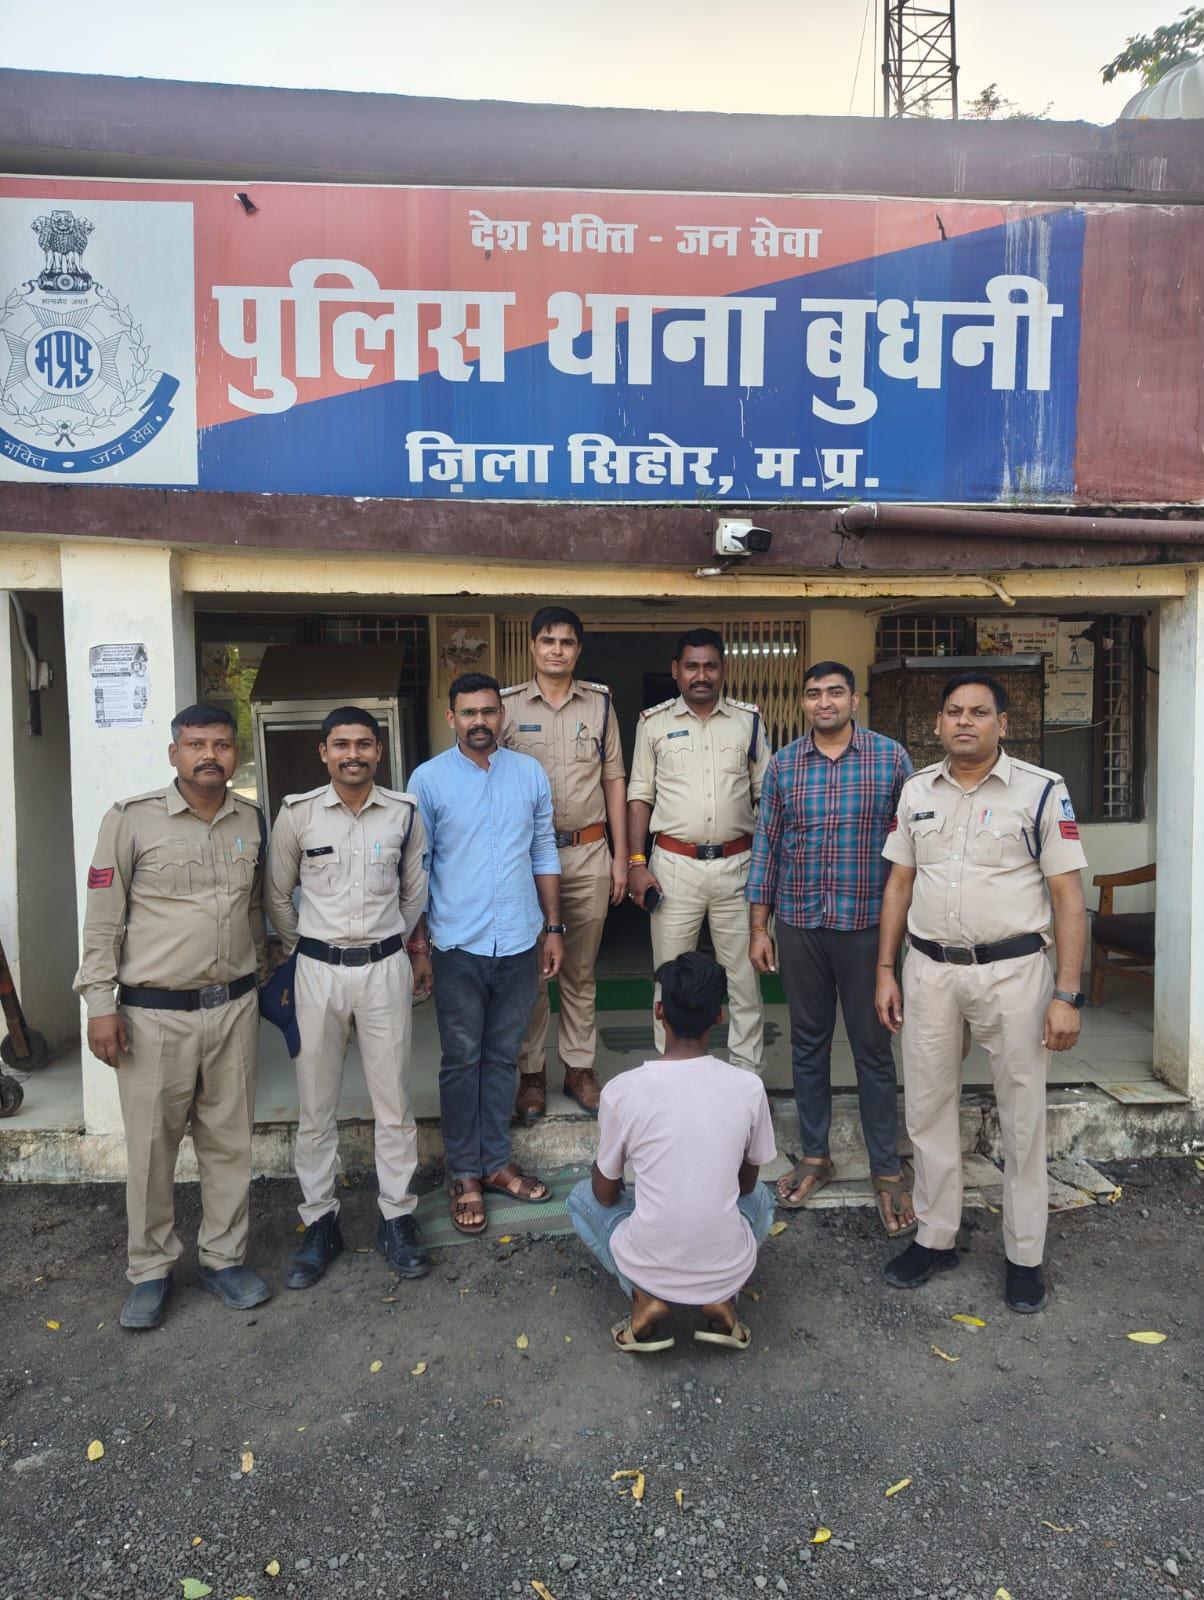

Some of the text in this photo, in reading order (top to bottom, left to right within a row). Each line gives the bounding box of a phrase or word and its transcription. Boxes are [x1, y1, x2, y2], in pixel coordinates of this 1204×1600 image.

[469, 210, 529, 252] देश
[542, 213, 638, 254] भक्ति
[676, 223, 739, 257] जन
[751, 217, 822, 259] सेवा
[211, 258, 1064, 425] पुलिस थाना बुधनी
[3, 422, 156, 468] भक्ति जन सेवा
[568, 433, 734, 494] सिहोर,
[755, 447, 880, 491] म.प्र.
